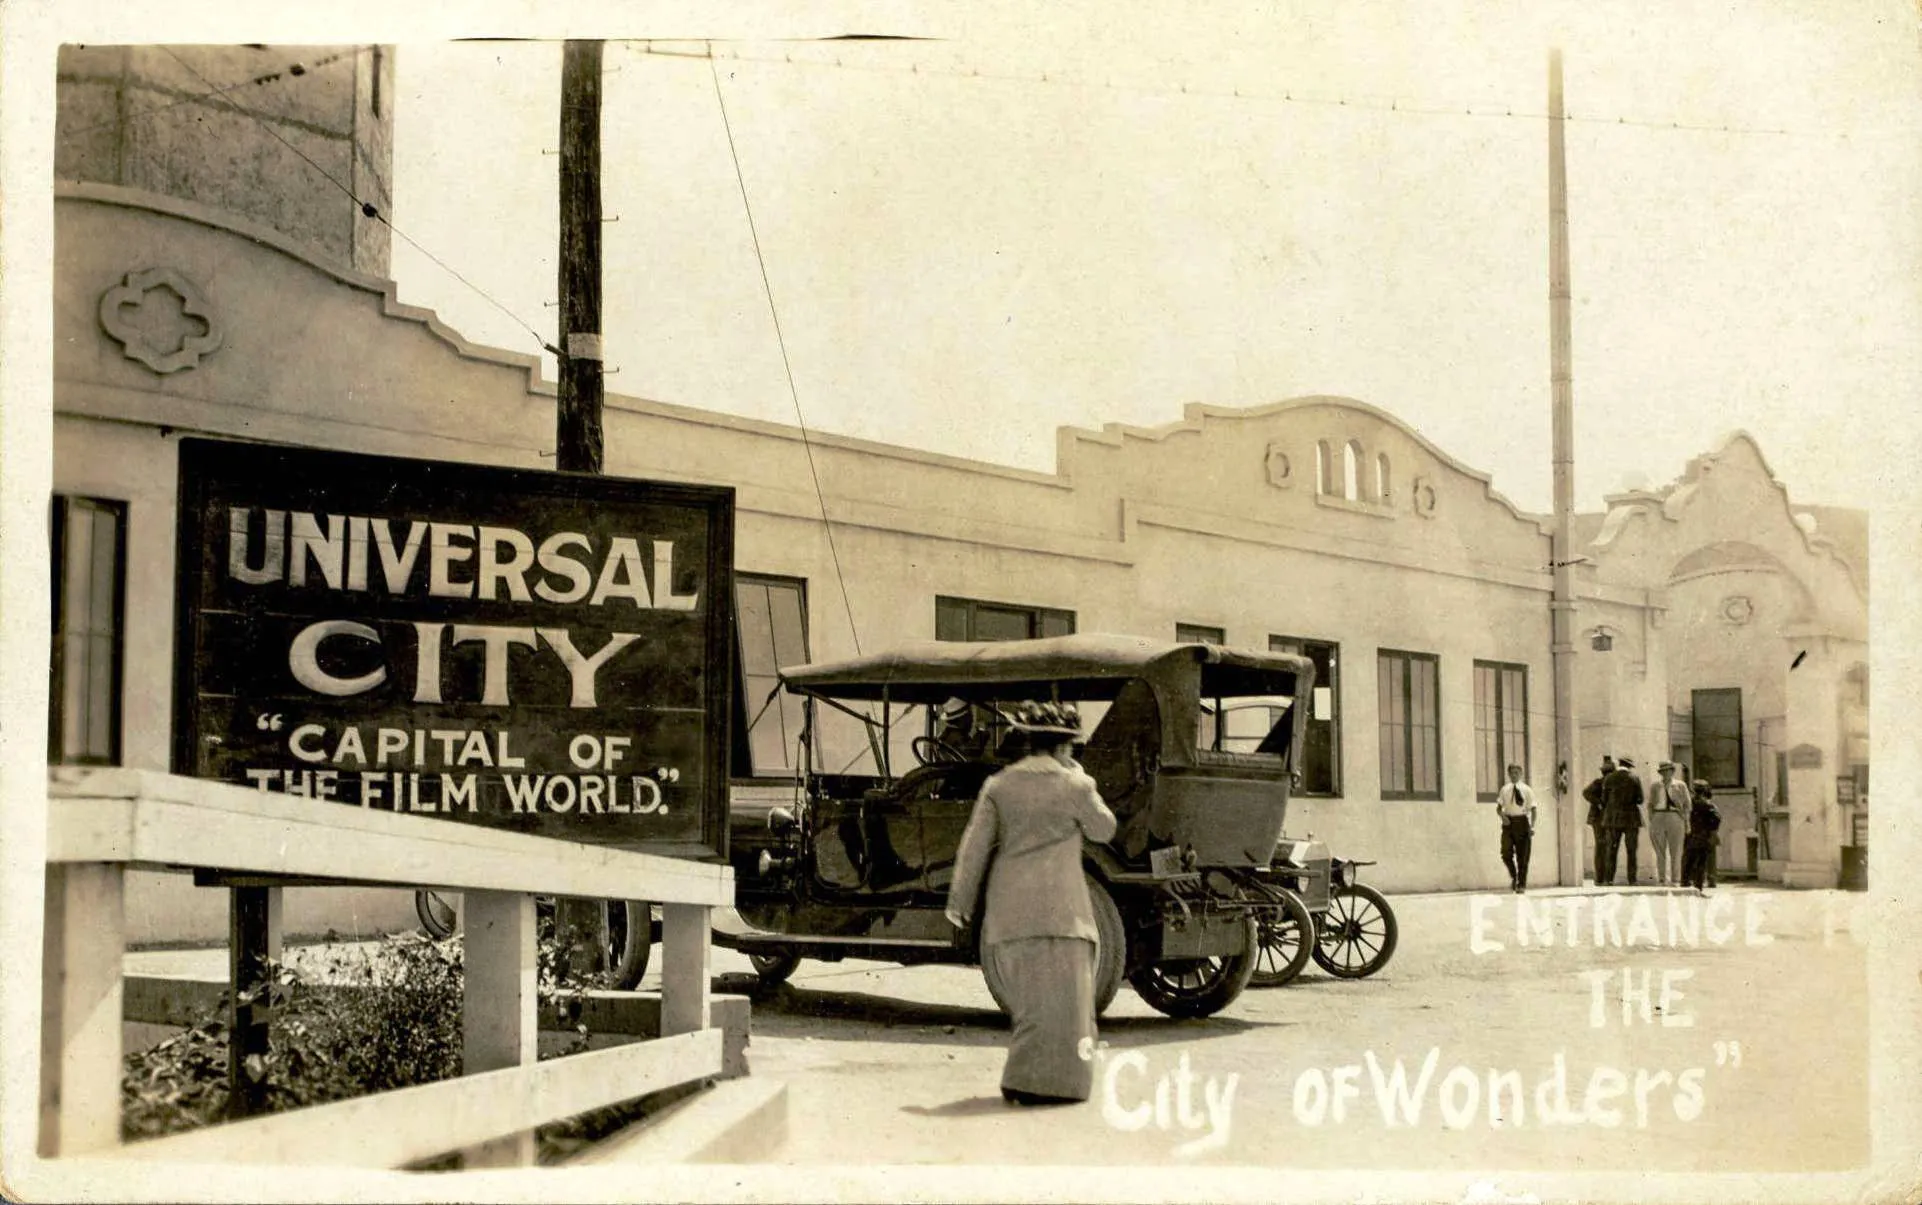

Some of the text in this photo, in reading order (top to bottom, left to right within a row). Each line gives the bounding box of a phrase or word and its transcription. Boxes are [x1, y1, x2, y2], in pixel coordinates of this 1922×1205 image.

[229, 506, 699, 610] UNIVERSAL
[289, 619, 641, 708] CITY
[256, 713, 632, 770] “CAPITAL OF
[246, 768, 338, 801] THE
[360, 771, 478, 814] FILM
